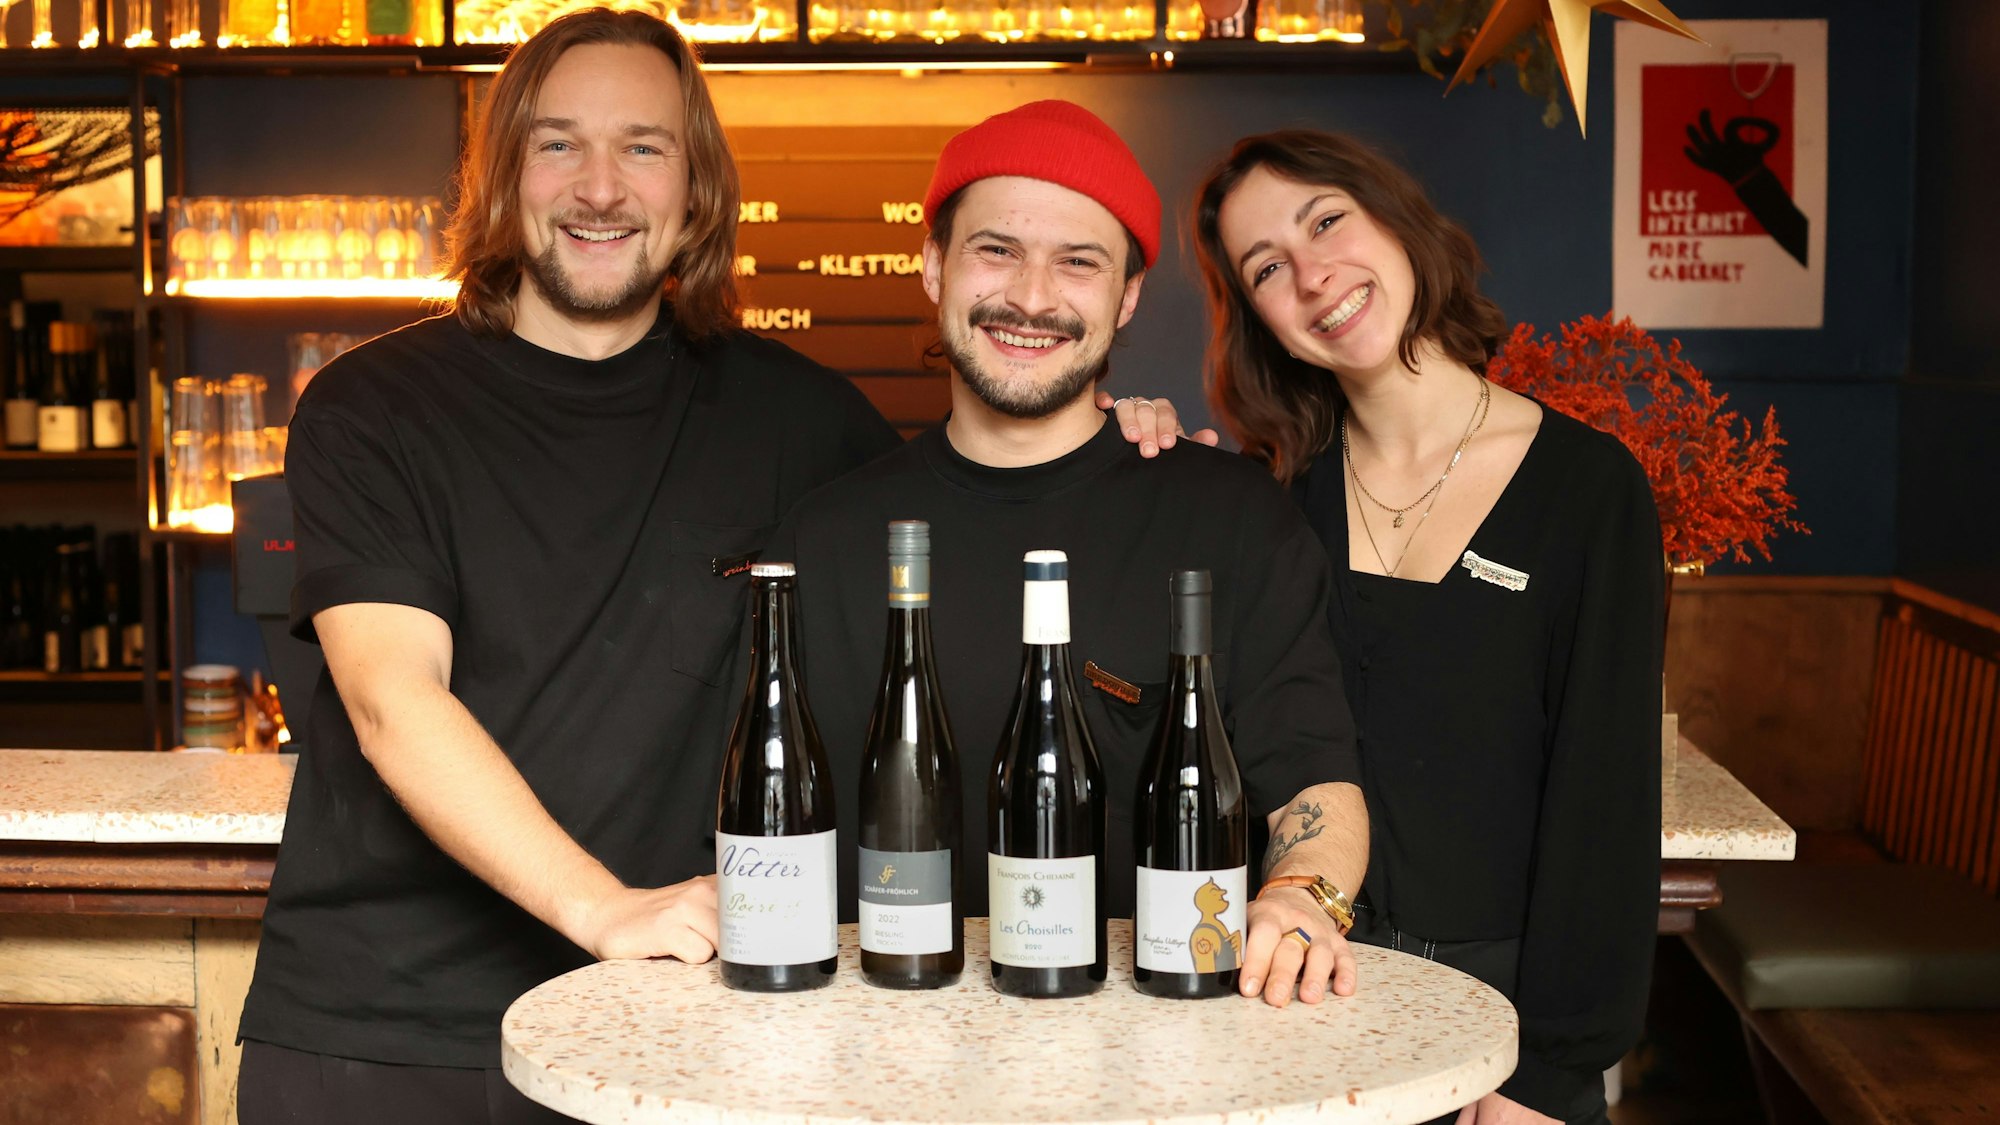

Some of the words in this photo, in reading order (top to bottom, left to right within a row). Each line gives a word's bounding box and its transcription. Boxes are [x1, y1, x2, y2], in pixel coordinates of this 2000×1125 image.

[1648, 190, 1697, 213] LESS
[1648, 211, 1746, 234] INTERNET
[1648, 240, 1702, 260] MORE
[1648, 262, 1744, 282] CABERNET
[720, 844, 807, 878] Vetter
[878, 912, 900, 924] 2022
[999, 920, 1014, 934] Les
[1016, 919, 1074, 936] Choisilles
[874, 929, 905, 939] RIESLING
